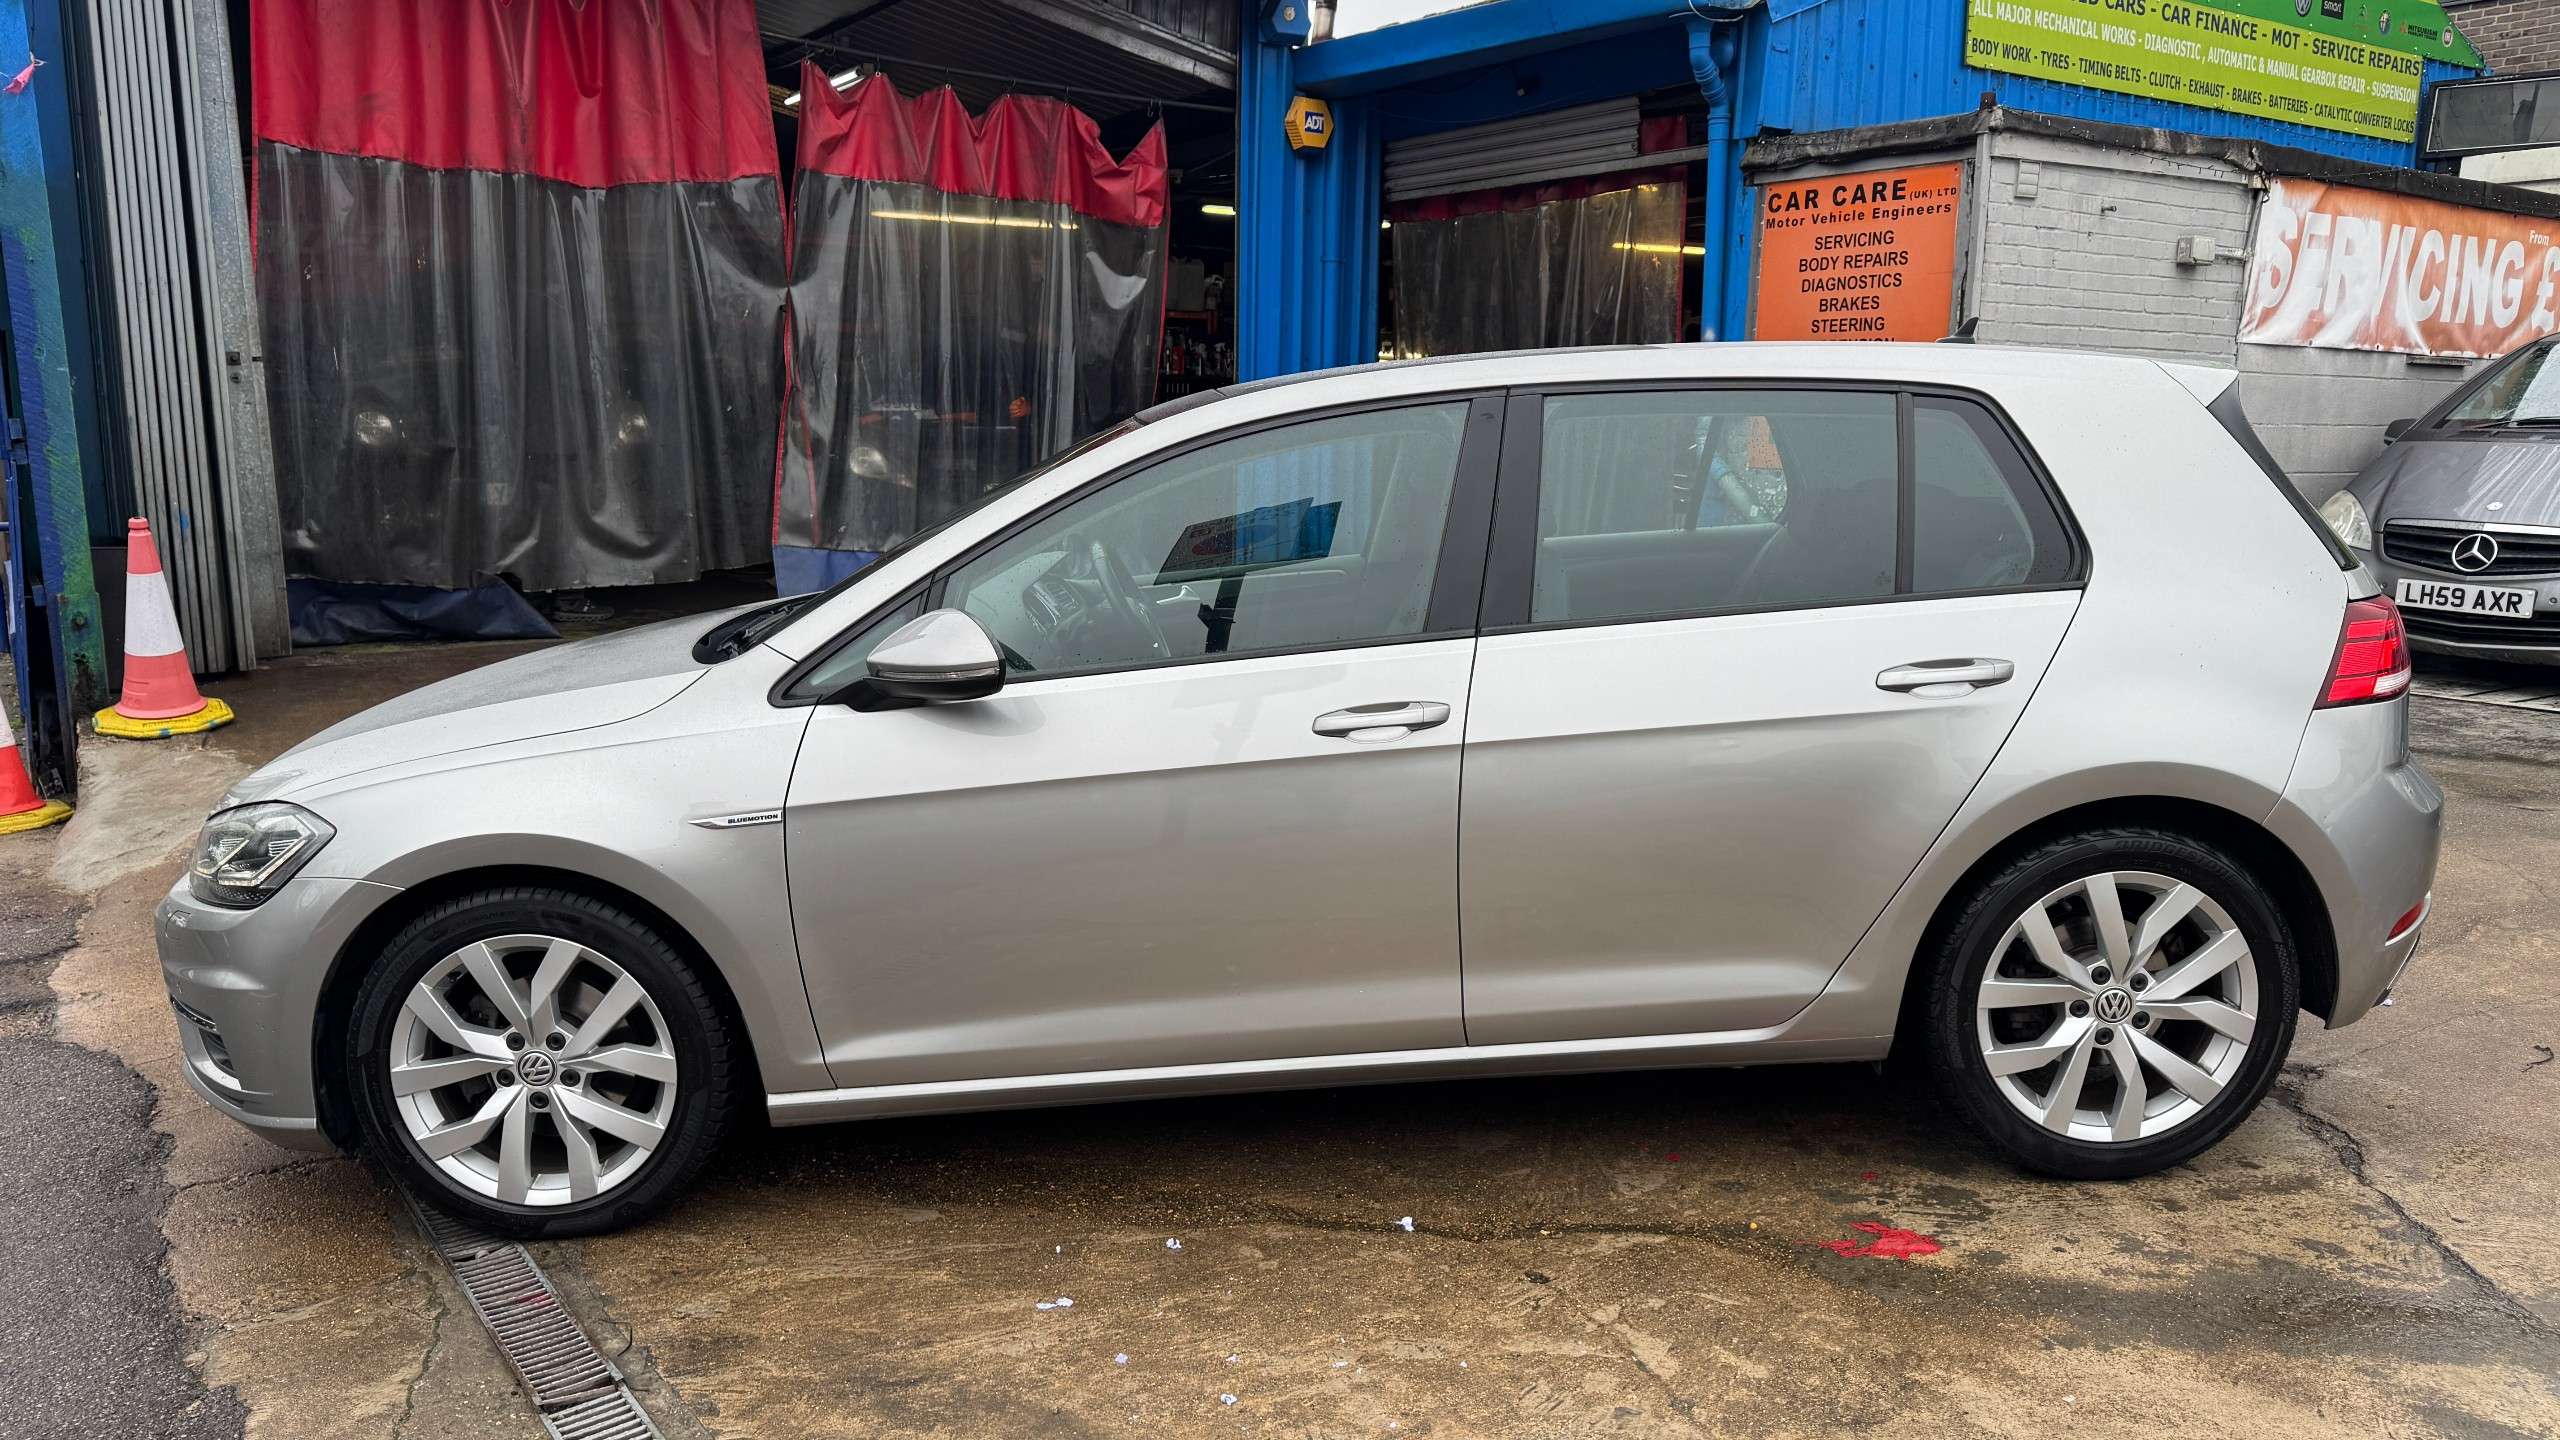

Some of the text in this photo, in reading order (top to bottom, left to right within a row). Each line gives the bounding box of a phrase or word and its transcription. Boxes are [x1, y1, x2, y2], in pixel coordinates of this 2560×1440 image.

[2162, 3, 2191, 27] CAR
[2195, 10, 2258, 41] FINANCE
[2271, 28, 2301, 50] MOT
[2312, 38, 2365, 65] SERVICE
[2368, 50, 2420, 77] REPAIRS
[1974, 0, 1994, 18] ALL
[1996, 2, 2032, 26] MAJOR
[2034, 10, 2099, 40] MECHANICAL
[2101, 23, 2137, 47] WORKS
[2207, 47, 2257, 72] AUTOMATIC
[2258, 62, 2265, 74] &
[2266, 58, 2300, 81] MANUAL
[2301, 65, 2337, 89] GEARBOX
[2338, 74, 2366, 95] REPAIR
[2371, 81, 2417, 104] SUSPENSION
[1972, 37, 2000, 57] BODY
[2002, 43, 2032, 63] WORK
[2041, 50, 2070, 70] TYRES
[2079, 57, 2112, 78] TIMING
[2114, 65, 2142, 83] BELTS
[2149, 71, 2181, 91] CLUTCH
[2188, 78, 2226, 100] EXHAUST
[2232, 87, 2262, 106] BRAKES
[2269, 94, 2309, 115] BATTERIES
[2314, 103, 2353, 122] CATALYTIC
[2353, 110, 2393, 130] CONVERTER
[2393, 117, 2415, 134] LOCKS
[1305, 115, 1325, 131] ADT
[1768, 179, 1957, 213] CAR CARE (UK) LTD
[1766, 203, 1952, 230] Motor Vehicle Engineers
[1814, 230, 1895, 251] SERVICING
[2528, 229, 2550, 246] From
[1798, 250, 1909, 273] BODY REPAIRS
[2256, 204, 2525, 329] SERVICING
[1801, 272, 1903, 293] DIAGNOSTICS
[1819, 295, 1880, 313] BRAKES
[1811, 316, 1885, 334] STEERING
[2404, 582, 2524, 614] LH59 AXR
[728, 814, 778, 824] BLUEMOTION
